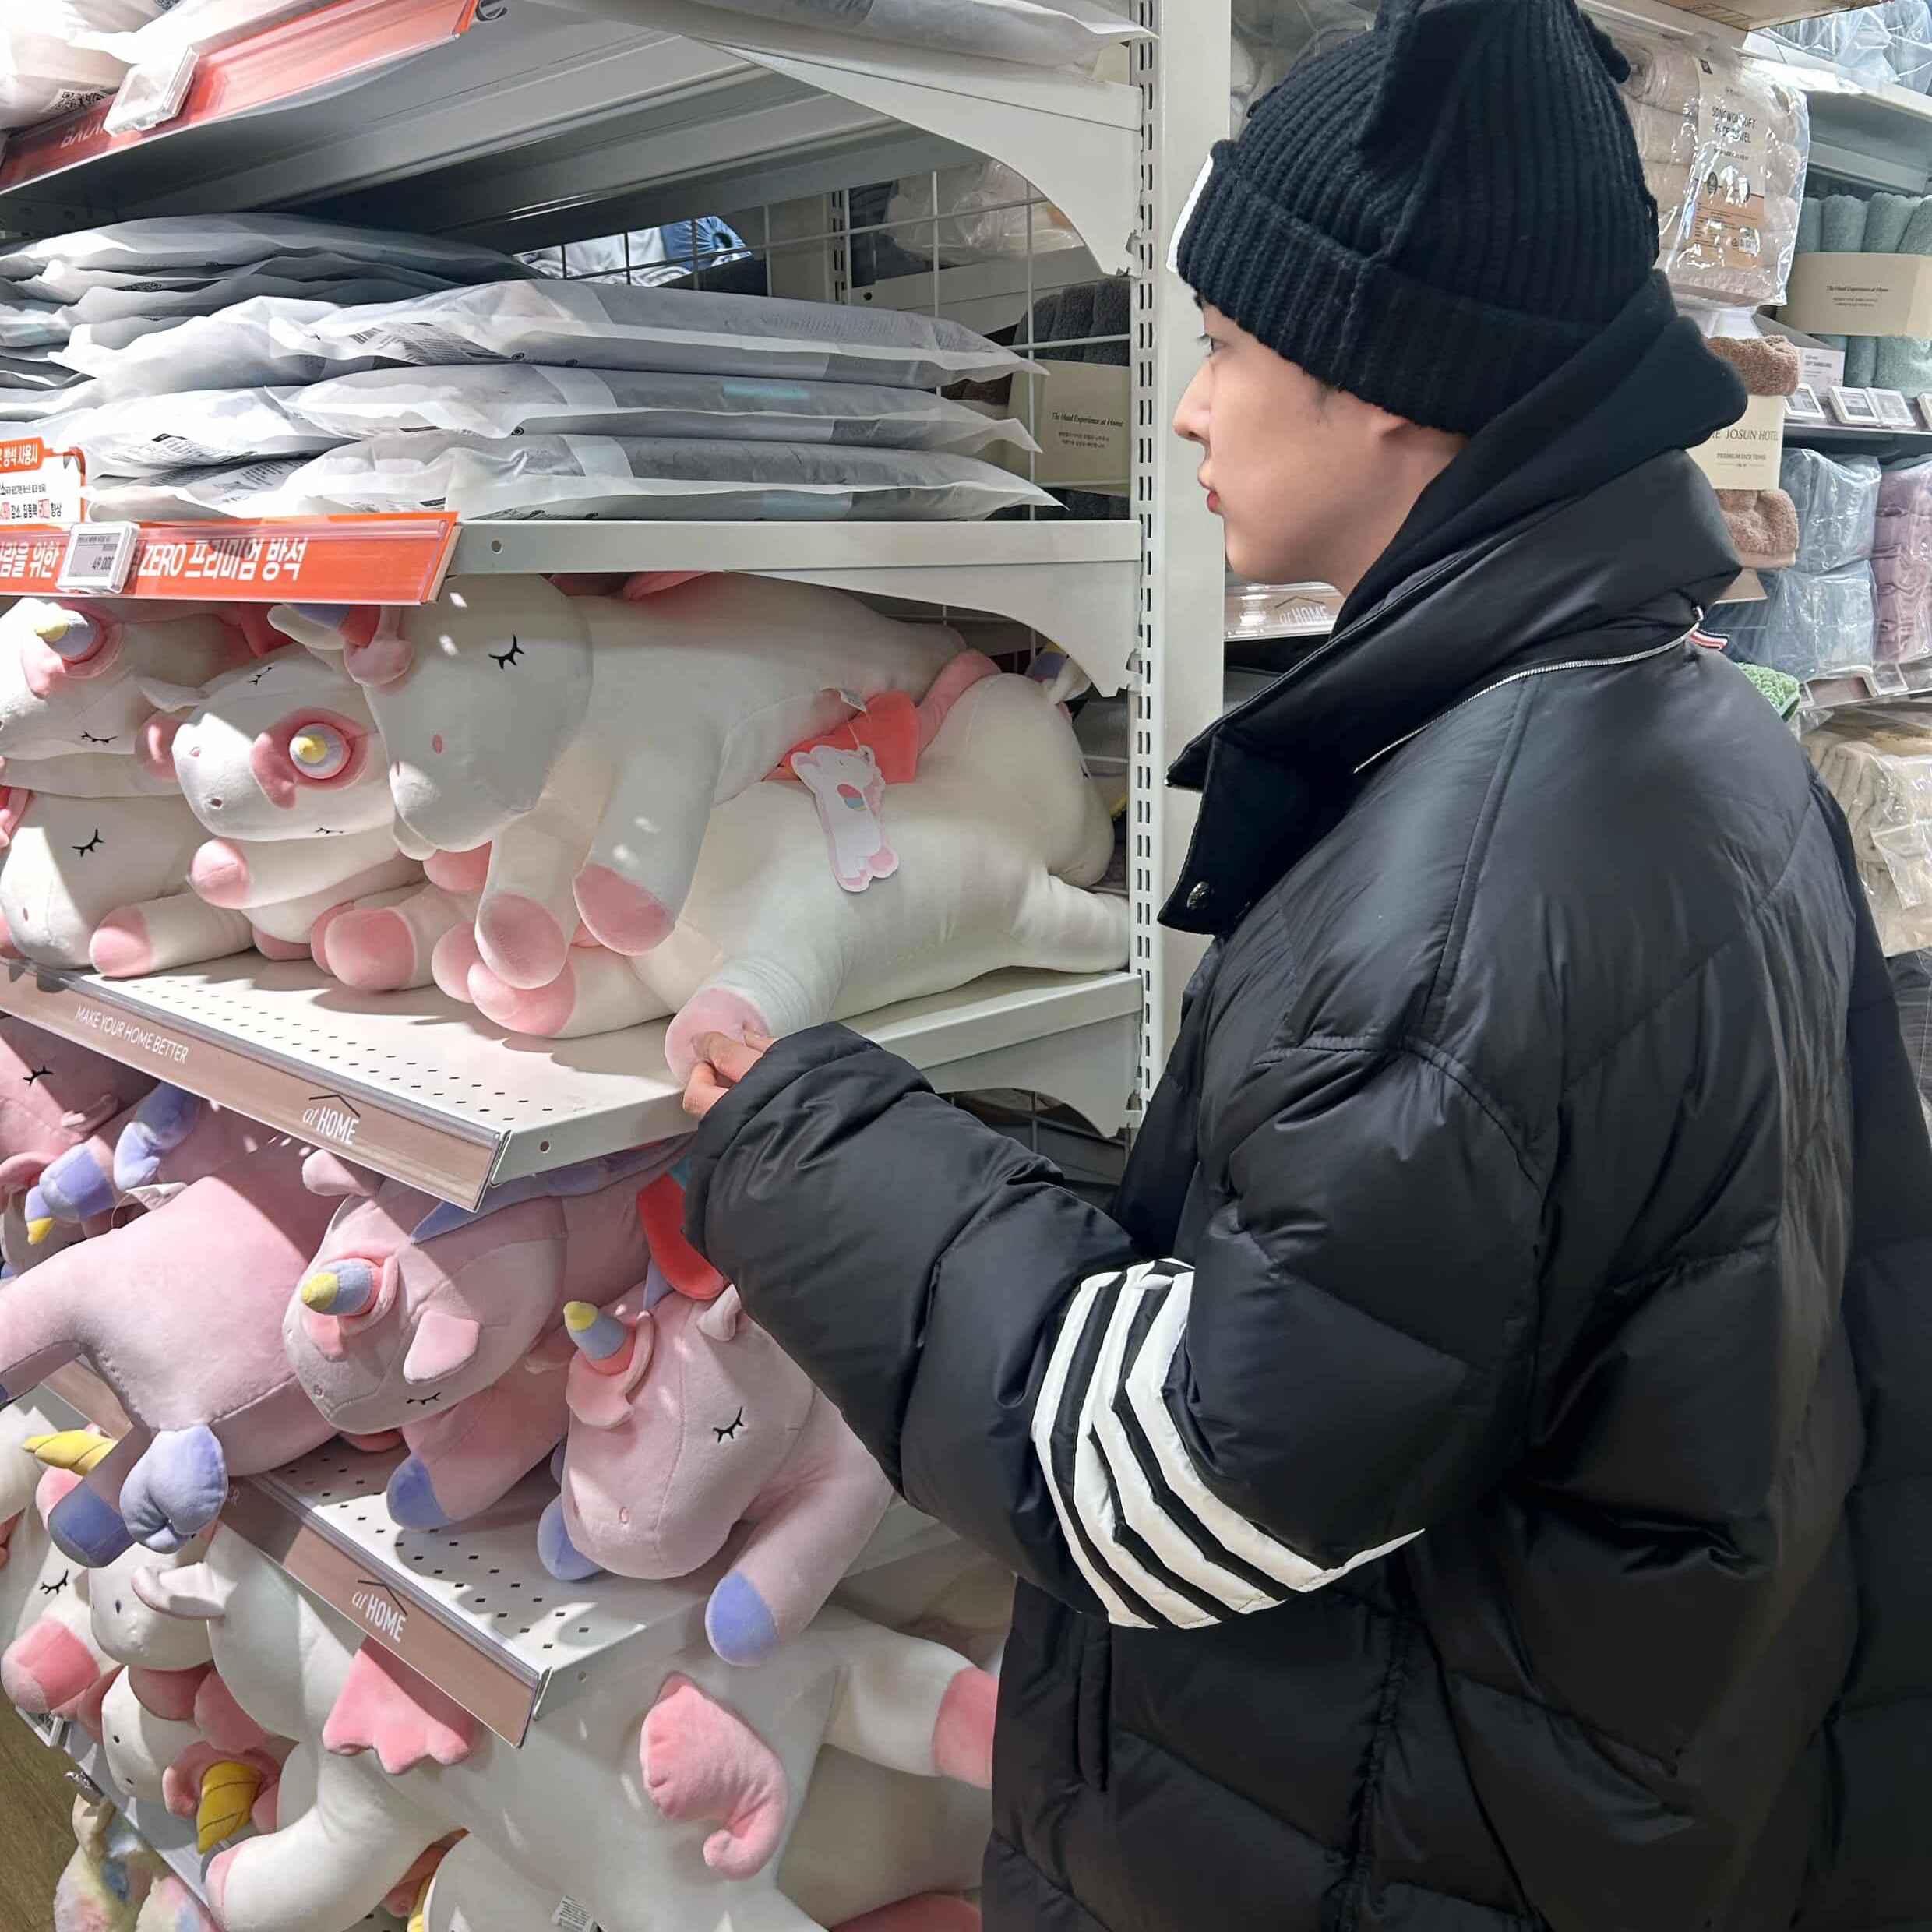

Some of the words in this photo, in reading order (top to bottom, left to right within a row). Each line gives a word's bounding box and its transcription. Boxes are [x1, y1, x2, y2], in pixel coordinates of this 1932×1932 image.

[1726, 428, 1757, 440] JOSUN
[51, 502, 62, 518] 향상
[30, 540, 60, 578] 위한
[137, 542, 187, 576] ZERO
[185, 538, 264, 580] 프리미엄
[262, 536, 309, 582] 방석
[1291, 605, 1327, 626] HOME
[75, 1005, 101, 1028] MAKE
[100, 1014, 125, 1037] YOUR
[125, 1024, 154, 1049] HOME
[152, 1035, 189, 1063] BETTER
[302, 1107, 319, 1126] at
[316, 1105, 359, 1145] HOME
[351, 1590, 368, 1610] at
[365, 1593, 407, 1643] HOME
